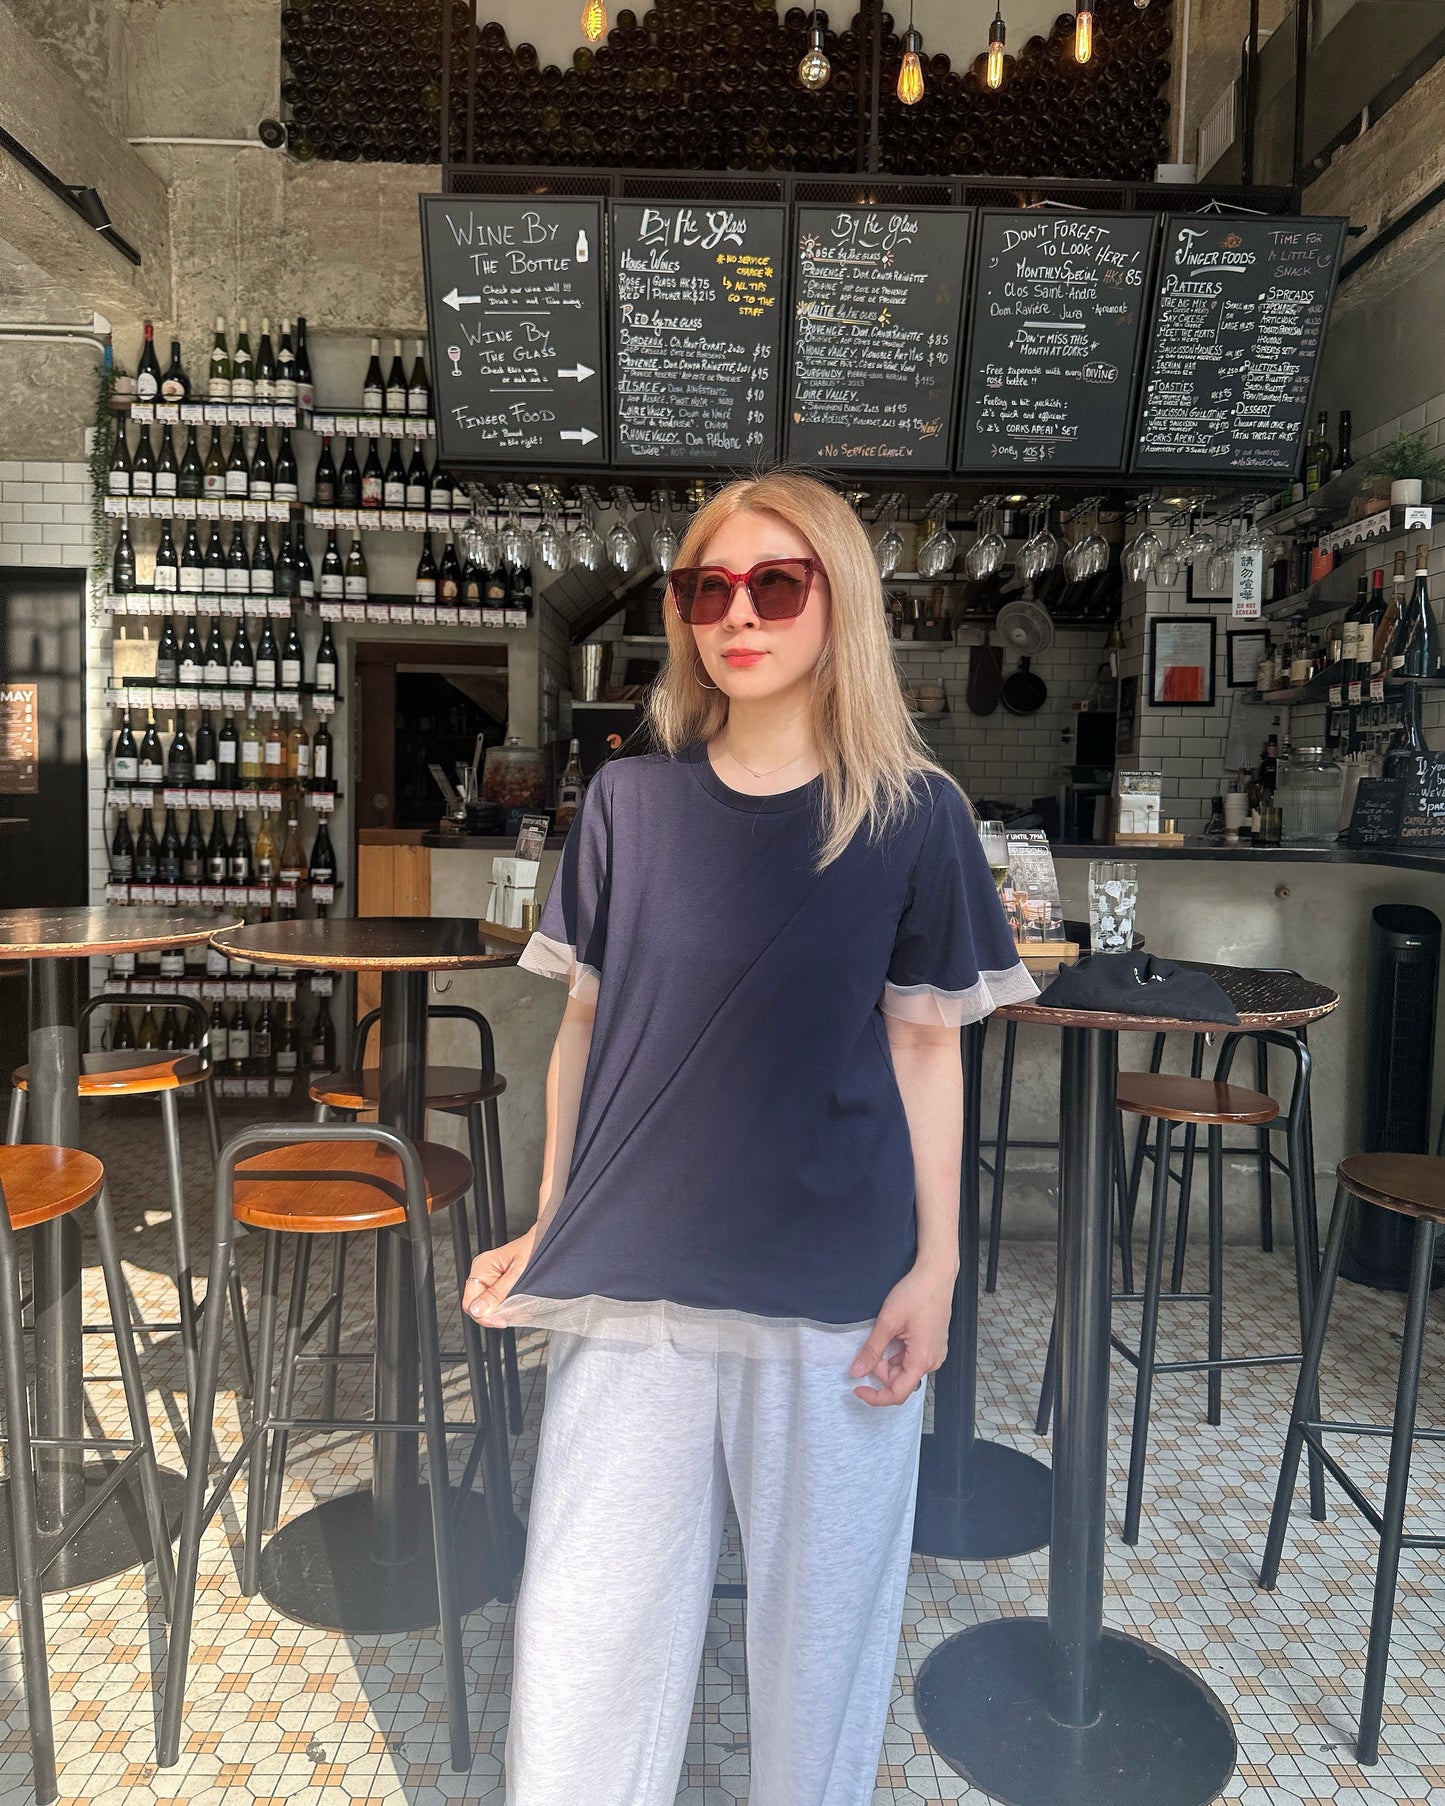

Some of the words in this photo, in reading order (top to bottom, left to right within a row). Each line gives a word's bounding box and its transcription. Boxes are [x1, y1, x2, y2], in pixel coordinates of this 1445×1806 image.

[445, 210, 516, 247] WINE
[637, 208, 671, 247] By
[830, 212, 860, 245] By
[1001, 224, 1049, 253] DON'T
[1053, 219, 1110, 243] FORGET
[1267, 230, 1302, 246] TIME
[1305, 232, 1323, 244] FOR
[1036, 240, 1057, 257] TO
[1060, 242, 1093, 256] LOOK
[1175, 228, 1218, 266] FINGER
[1221, 252, 1257, 265] FOODS
[621, 248, 647, 270] HOUSE
[649, 249, 681, 271] WINES
[737, 255, 771, 266] SERVICE
[1267, 250, 1277, 262] A
[1280, 248, 1319, 261] LITTLE
[469, 253, 499, 276] THE
[505, 250, 572, 275] BOTTLE
[1016, 256, 1061, 279] MONTHLY
[1273, 265, 1313, 278] SNACK
[652, 275, 677, 287] GLASS
[734, 282, 748, 291] ALL
[748, 282, 767, 292] TIPS
[1165, 274, 1223, 295] PLATTERS
[482, 284, 508, 295] Check
[524, 286, 542, 294] wine
[544, 282, 560, 293] wall
[618, 284, 647, 294] WHITE
[1004, 282, 1029, 298] Clos
[1266, 286, 1315, 301] SPREADS
[619, 292, 641, 301] RED
[727, 294, 741, 303] GO
[743, 295, 755, 304] TO
[757, 297, 776, 307] THE
[1192, 300, 1208, 308] MIX
[738, 306, 765, 317] STAFF
[1059, 303, 1083, 320] Jura
[1162, 312, 1179, 323] SAY
[679, 317, 703, 329] GLASS
[460, 321, 513, 346] WINE
[927, 333, 949, 348] $85
[1015, 330, 1044, 344] DON'T
[1045, 333, 1070, 345] MISS
[1070, 334, 1089, 346] THIS
[479, 350, 505, 363] THE
[512, 347, 557, 362] GLASS
[1019, 345, 1049, 356] MONTH
[1049, 346, 1061, 357] AT
[1061, 345, 1090, 358] CORKS
[480, 366, 505, 375] Check
[506, 366, 522, 374] this
[1007, 366, 1042, 378] tapenade
[1045, 367, 1061, 377] with
[1064, 369, 1082, 381] every
[1085, 368, 1115, 380] DIVINE
[1005, 376, 1029, 387] bottle
[1151, 379, 1195, 393] TOASTIES
[983, 394, 1008, 411] Feeling
[1011, 399, 1018, 407] a
[1019, 398, 1031, 407] bit
[1235, 401, 1276, 416] DESSERT
[452, 405, 508, 429] FINGER
[509, 402, 556, 423] FOOD
[999, 410, 1019, 421] quick
[1022, 411, 1035, 420] and
[1005, 424, 1030, 435] CORKS
[1061, 425, 1079, 436] SET
[1145, 433, 1173, 443] CORKS
[825, 444, 839, 457] NO
[840, 443, 877, 457] SERVICE
[877, 444, 907, 458] CHARGE
[998, 446, 1019, 460] Only
[0, 690, 34, 703] MAY
[1010, 833, 1030, 842] UNTIL
[1029, 833, 1044, 841] 7PM
